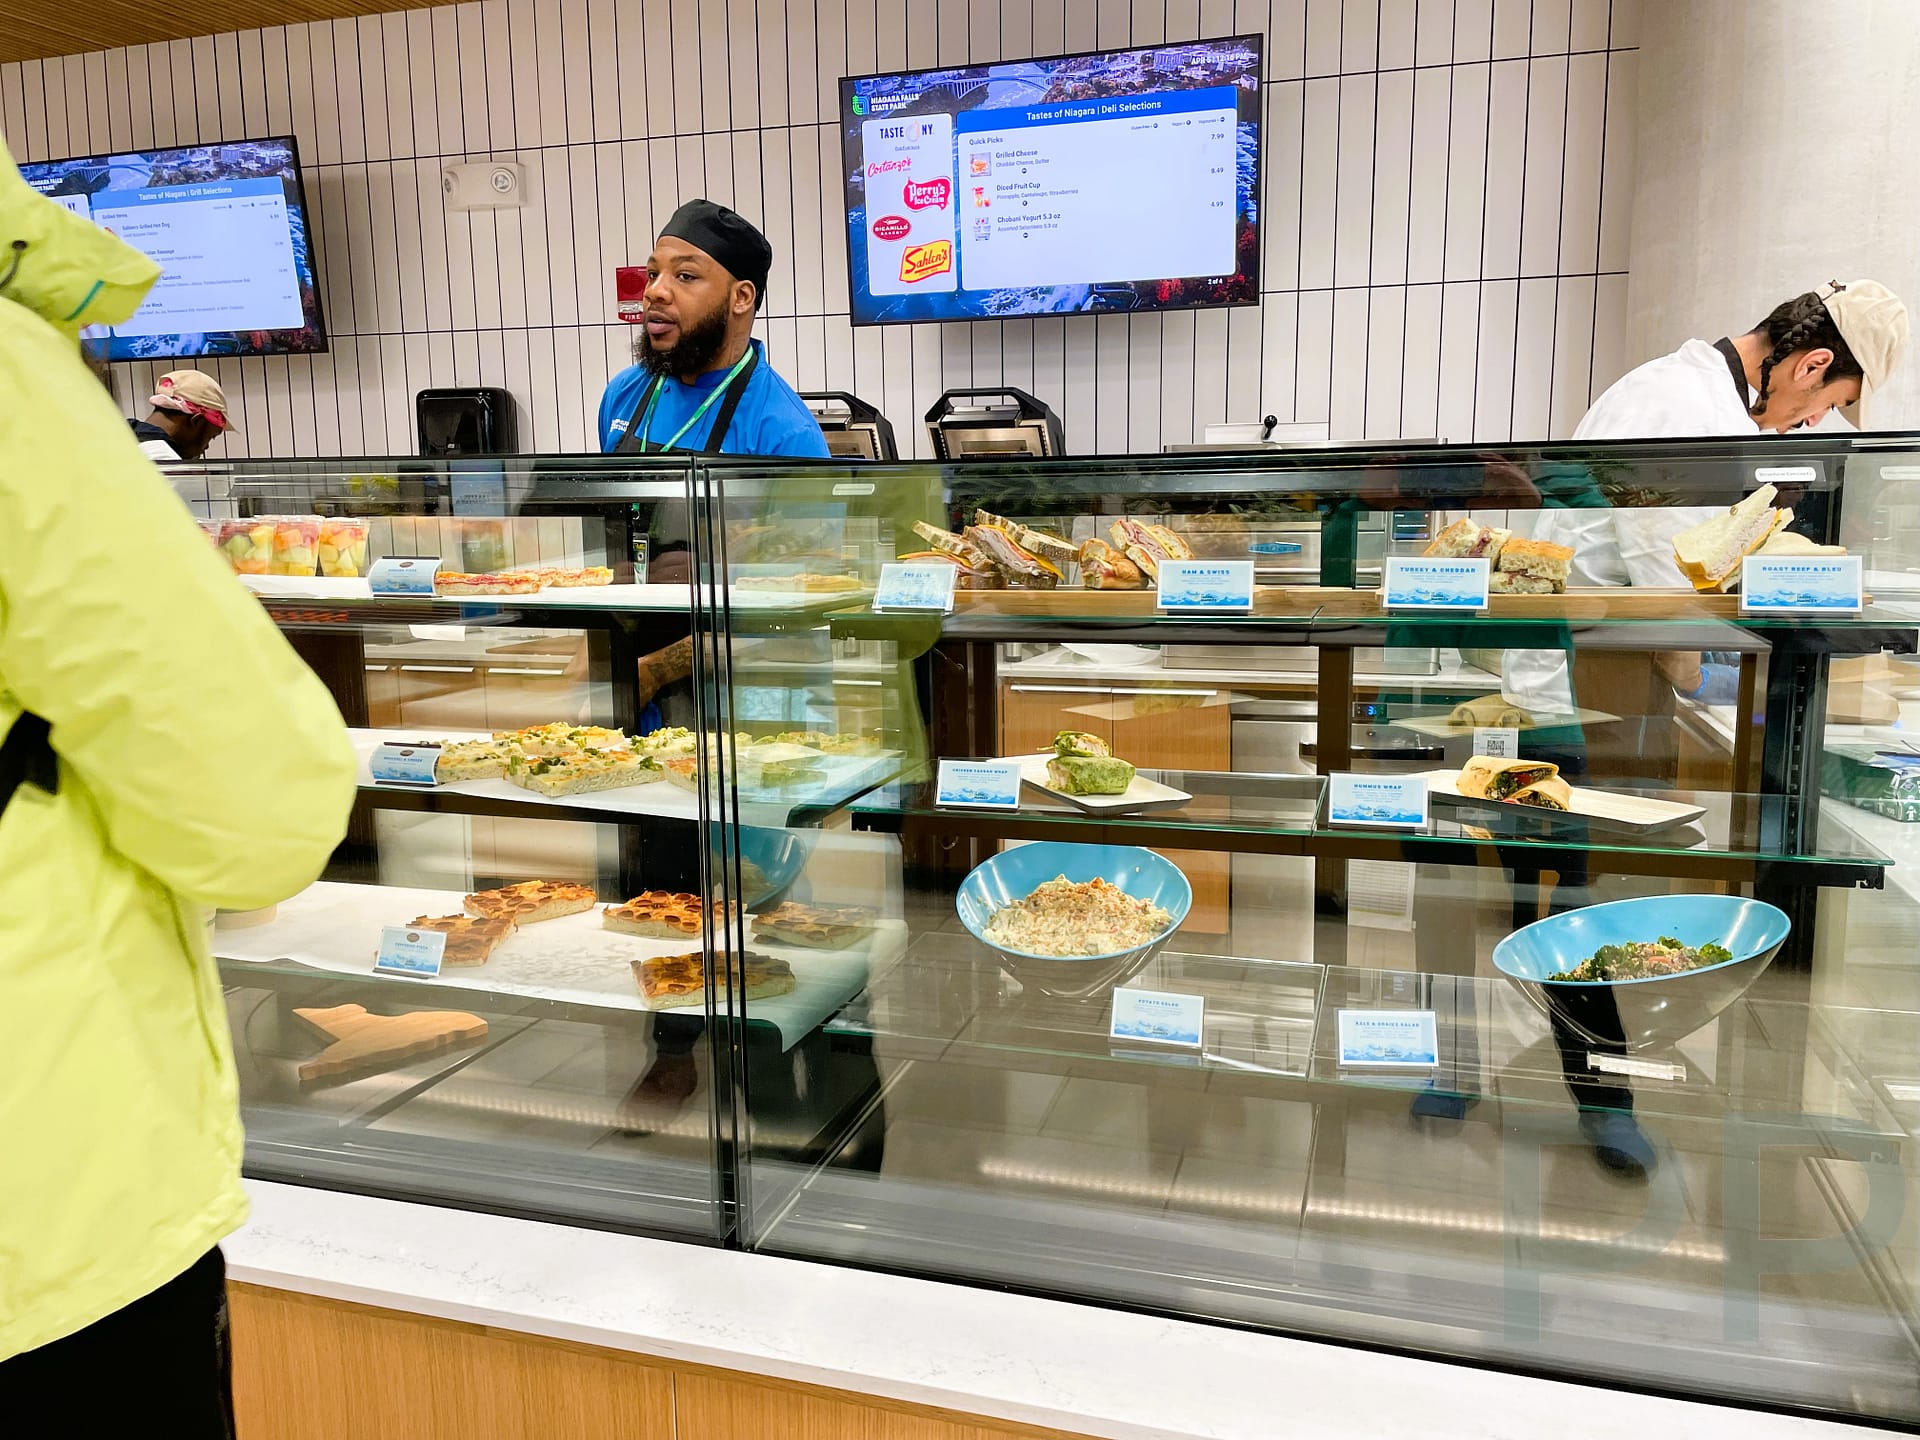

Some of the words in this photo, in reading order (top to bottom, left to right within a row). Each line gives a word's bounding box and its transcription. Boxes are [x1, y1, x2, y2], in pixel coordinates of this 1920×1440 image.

[871, 95, 900, 104] NIAGARA
[890, 102, 906, 110] PARK
[1026, 112, 1052, 120] Tastes
[1054, 110, 1062, 118] of
[1064, 107, 1095, 118] Niagara
[1102, 104, 1116, 113] Deli
[1119, 100, 1162, 112] Selections
[880, 127, 904, 139] TASTE
[922, 124, 933, 135] NY
[969, 138, 986, 146] Quick
[987, 136, 1003, 144] Picks
[868, 156, 912, 178] Costanzo's
[139, 192, 157, 200] Tastes
[158, 191, 164, 199] of
[165, 190, 186, 199] Niagara
[190, 188, 202, 196] Grill
[203, 186, 232, 195] Selections
[908, 184, 945, 202] Perry's
[914, 197, 923, 205] Ice
[924, 196, 944, 204] Cream
[905, 248, 948, 274] Sahlen's
